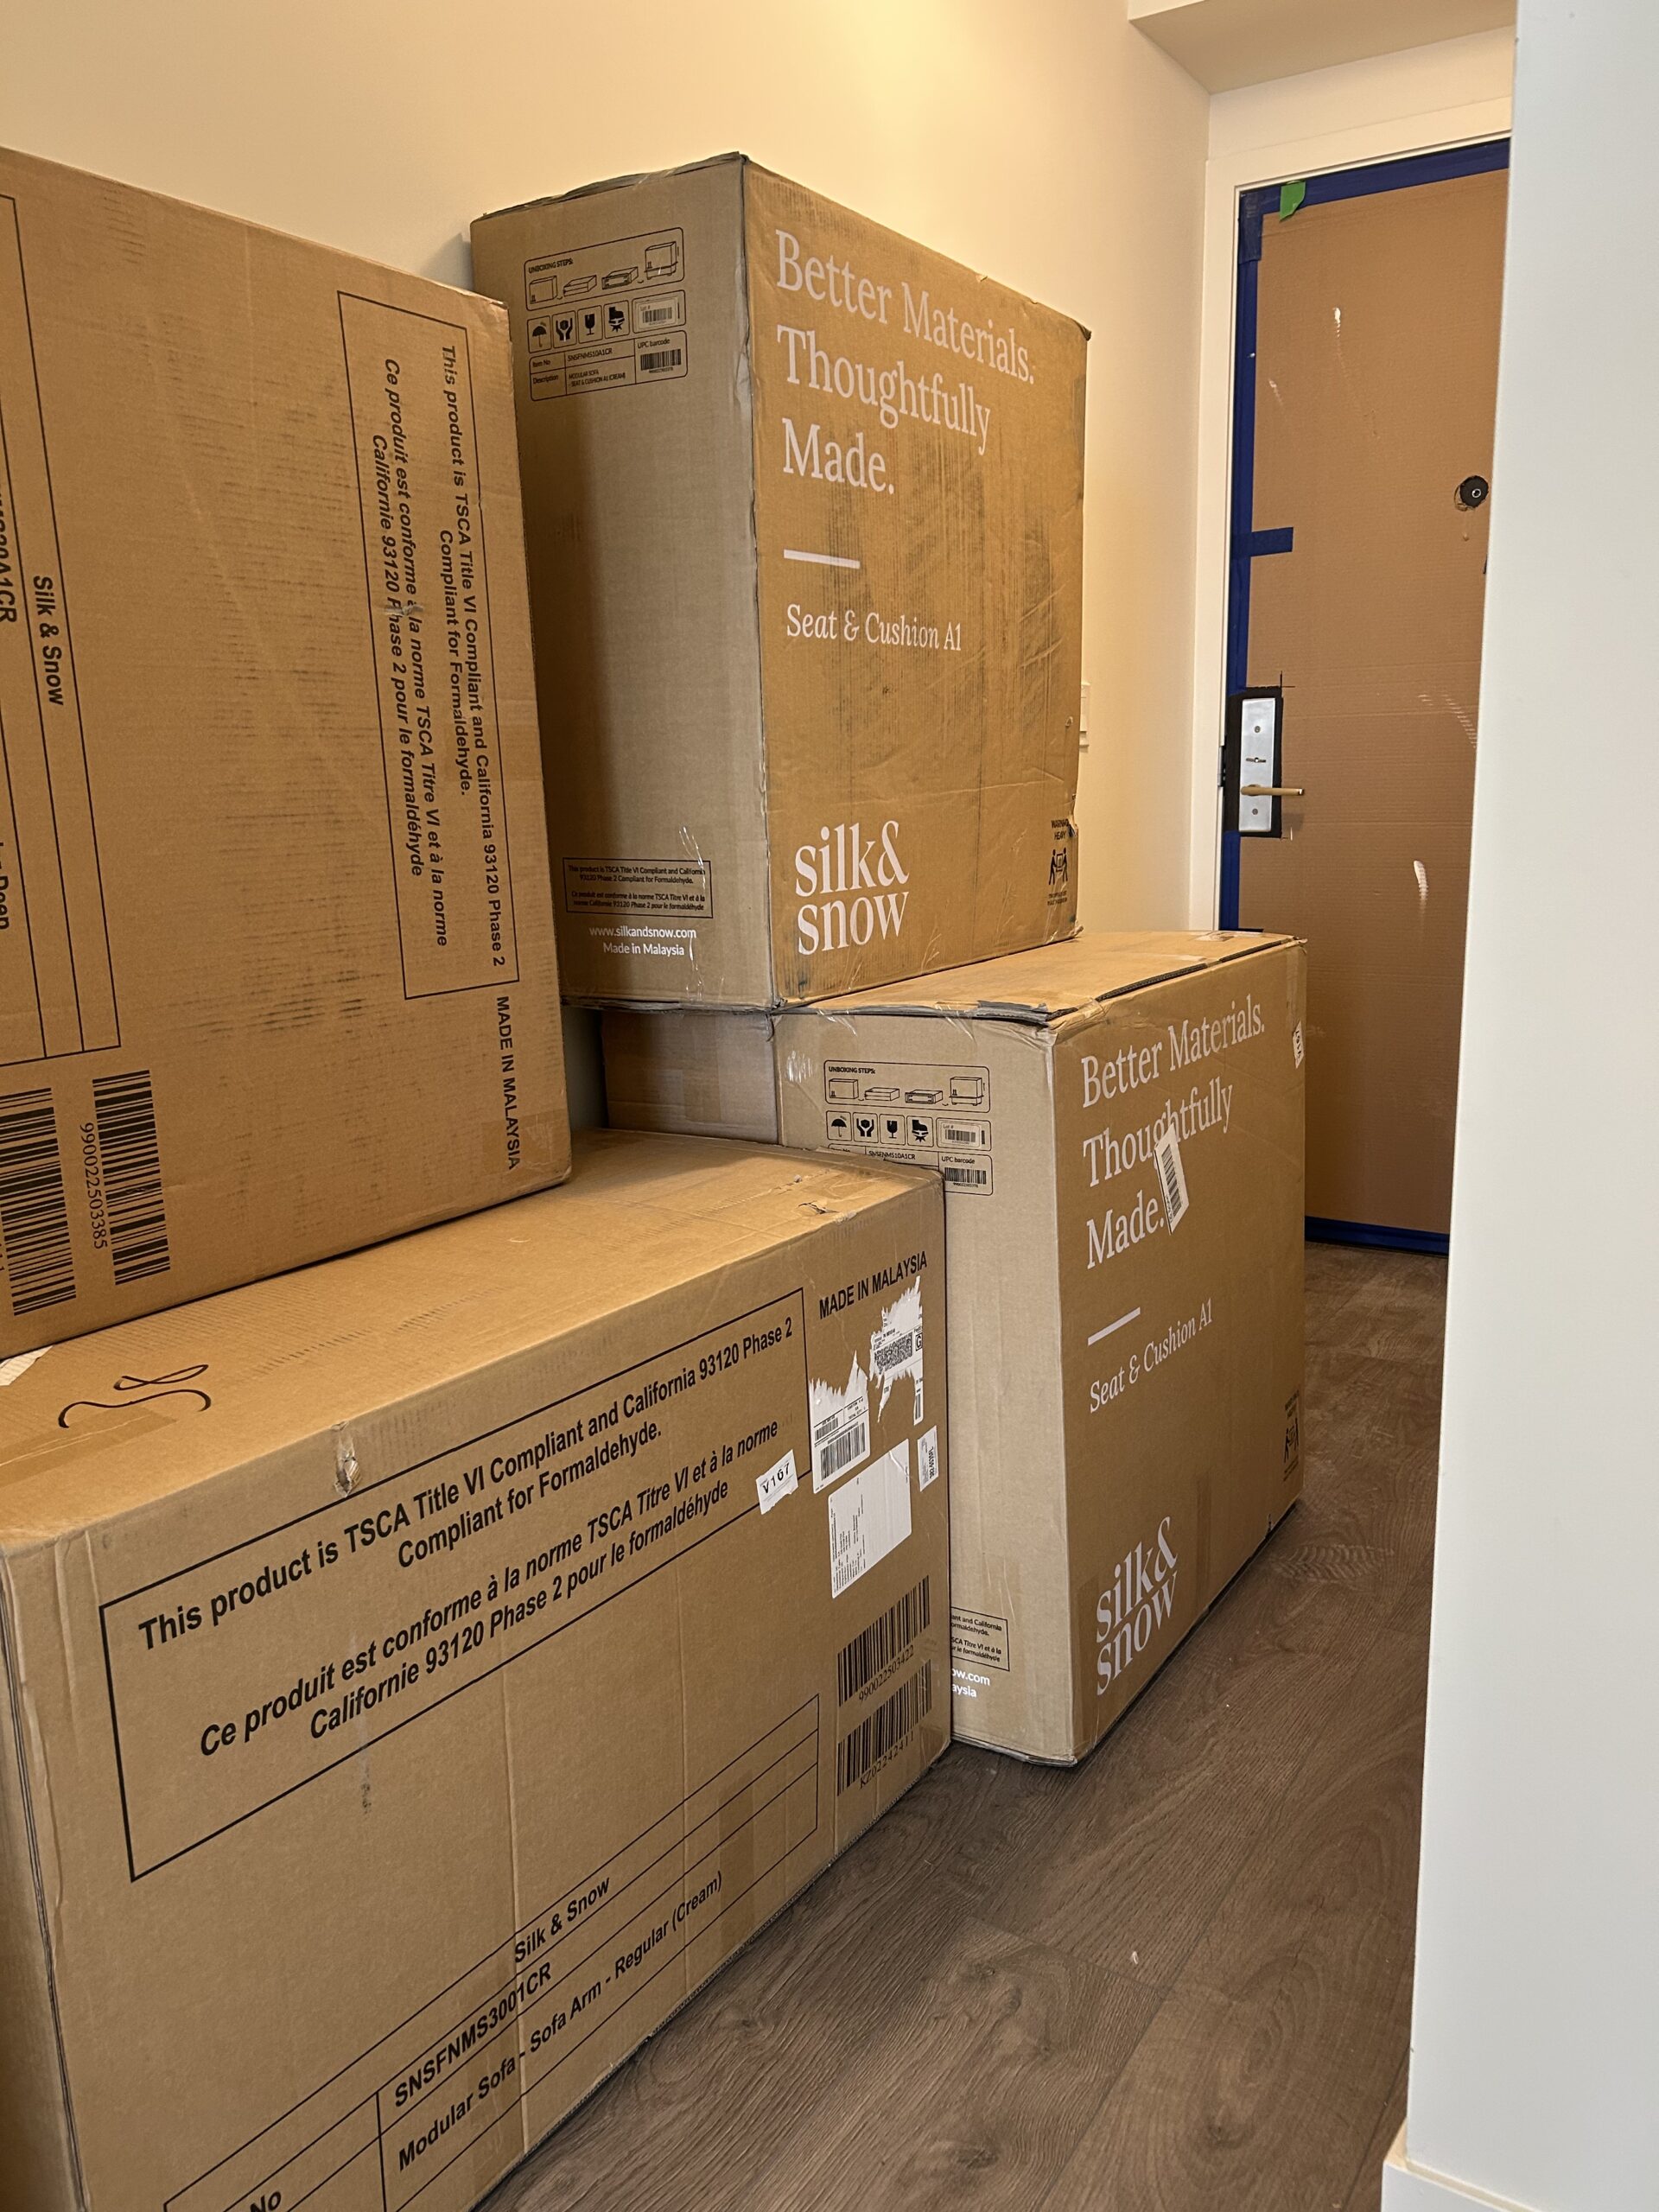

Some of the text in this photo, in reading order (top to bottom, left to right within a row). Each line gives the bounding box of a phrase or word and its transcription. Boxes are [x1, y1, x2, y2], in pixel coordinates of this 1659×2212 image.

[776, 229, 1035, 385] Better Materials.
[777, 324, 990, 456] Thoughtfully
[782, 416, 895, 495] Made.
[33, 575, 64, 706] Silk & Snow
[372, 434, 425, 877] Californie 93120 Phase 2 pour le formaldéhyde
[385, 359, 448, 947] Ce produit est conforme la norme TSCA Titre VI et à la norme
[440, 530, 473, 796] Compliant for Formaldehyde.
[442, 346, 505, 967] This product is TSCA Title VI Compliant and California 93120 Phase 2
[786, 603, 963, 652] Seat & Cushion A1
[794, 820, 910, 898] silk&
[588, 925, 697, 939] www.silkandsnow.com
[603, 943, 685, 957] Made in Malaysia
[797, 891, 910, 956] snow
[497, 995, 521, 1170] MADE IN MALAYSIA
[1081, 1041, 1163, 1109] Better
[1167, 994, 1265, 1071] Materials.
[79, 1122, 108, 1249] 990022503385
[1083, 1077, 1233, 1188] Thoughtfully
[819, 1251, 927, 1319] MADE IN MALAYSIA
[1086, 1189, 1165, 1270] Made.
[1090, 1298, 1213, 1414] Seat & Cushion A1
[138, 1317, 792, 1650] This product is TSCA Title VI Compliant and California 93120 Phase 2
[397, 1421, 662, 1567] Compliant for Formaldehyde.
[200, 1720, 237, 1757] Ce
[244, 1664, 336, 1741] produit
[340, 1644, 377, 1680] est
[381, 1588, 482, 1659] conforme
[487, 1572, 499, 1602] à
[504, 1564, 520, 1593] la
[526, 1533, 582, 1579] norme
[587, 1507, 633, 1545] TSCA
[636, 1484, 671, 1517] Titre
[674, 1467, 690, 1492] VI
[692, 1460, 707, 1481] et
[709, 1448, 719, 1471] à
[721, 1441, 734, 1464] la
[736, 1420, 779, 1459] norme
[309, 1479, 728, 1739] Californie 93120 Phase 2 pour le formaldéhyde
[1096, 1516, 1178, 1643] silk&
[1096, 1571, 1178, 1696] snow
[859, 1644, 914, 1702] 990022503422
[963, 1639, 976, 1648] Titre
[513, 1877, 610, 1964] Silk & Snow
[394, 1961, 553, 2108] SNSFNMS3001CR
[397, 2090, 474, 2174] Modular
[478, 2055, 517, 2101] Sofa
[530, 2012, 567, 2054] Sofa
[569, 1980, 602, 2019] Arm
[614, 1920, 670, 1980] Regular
[671, 1870, 723, 1932] (Cream)
[249, 2190, 283, 2212] No
